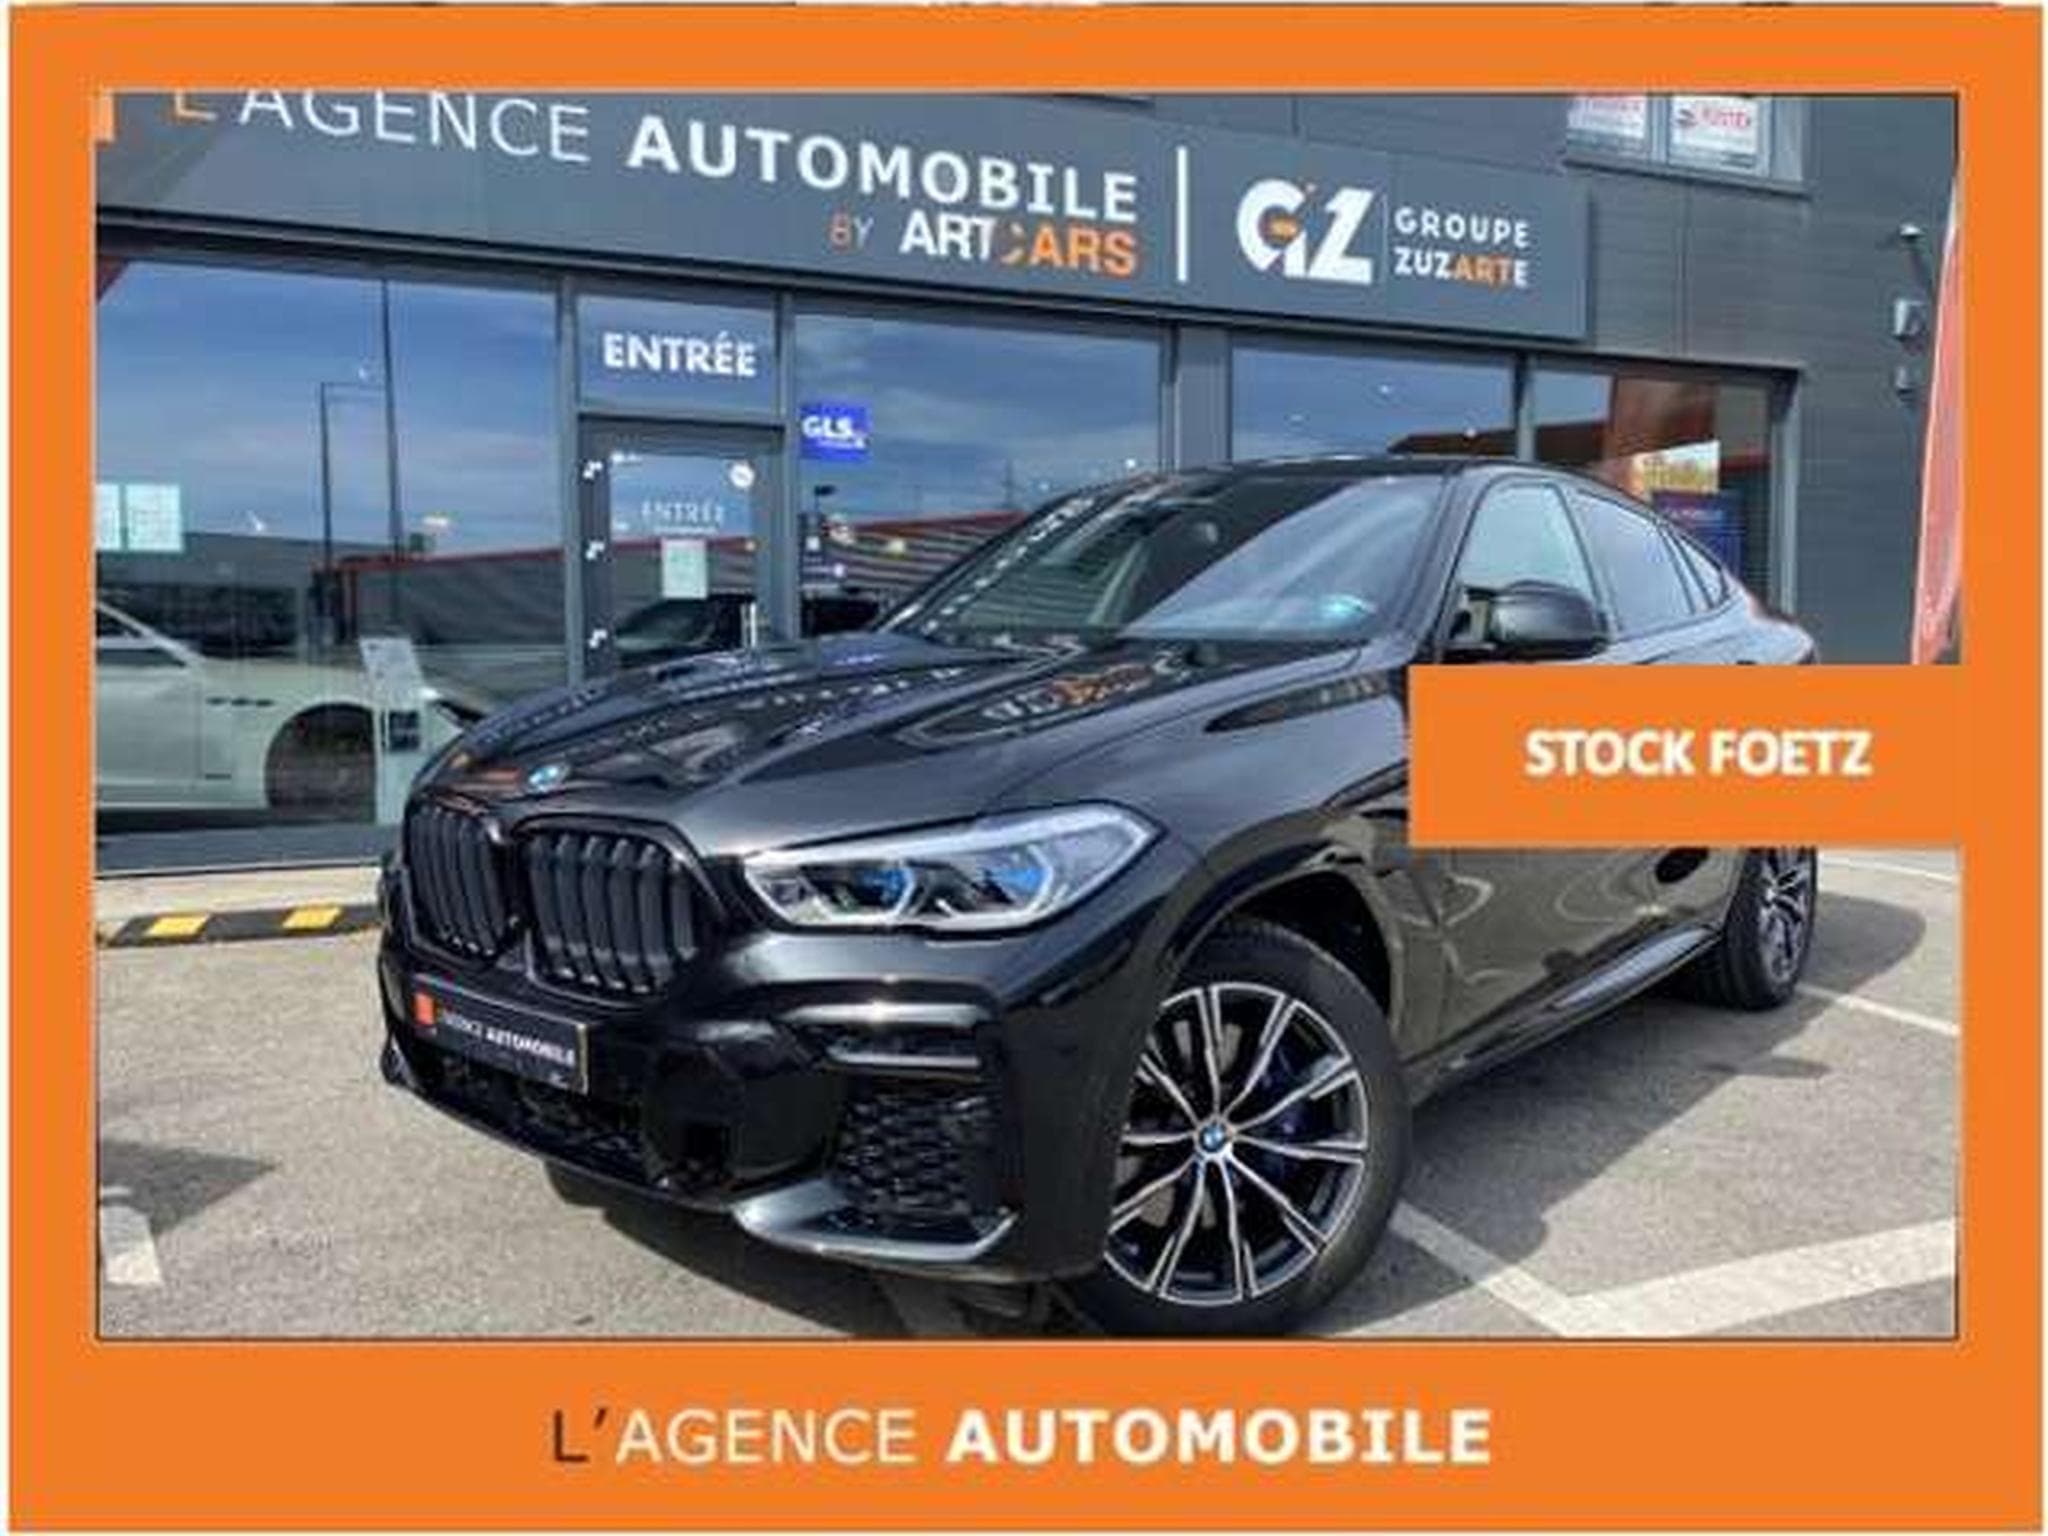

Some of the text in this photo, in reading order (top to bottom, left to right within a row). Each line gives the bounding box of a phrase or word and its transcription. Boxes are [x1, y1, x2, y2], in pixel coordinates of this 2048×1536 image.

[626, 115, 1138, 223] AUTOMOBILE
[1394, 206, 1530, 248] GROUPE
[1394, 246, 1529, 289] ZUZARTE
[602, 330, 757, 378] ENTRÉE
